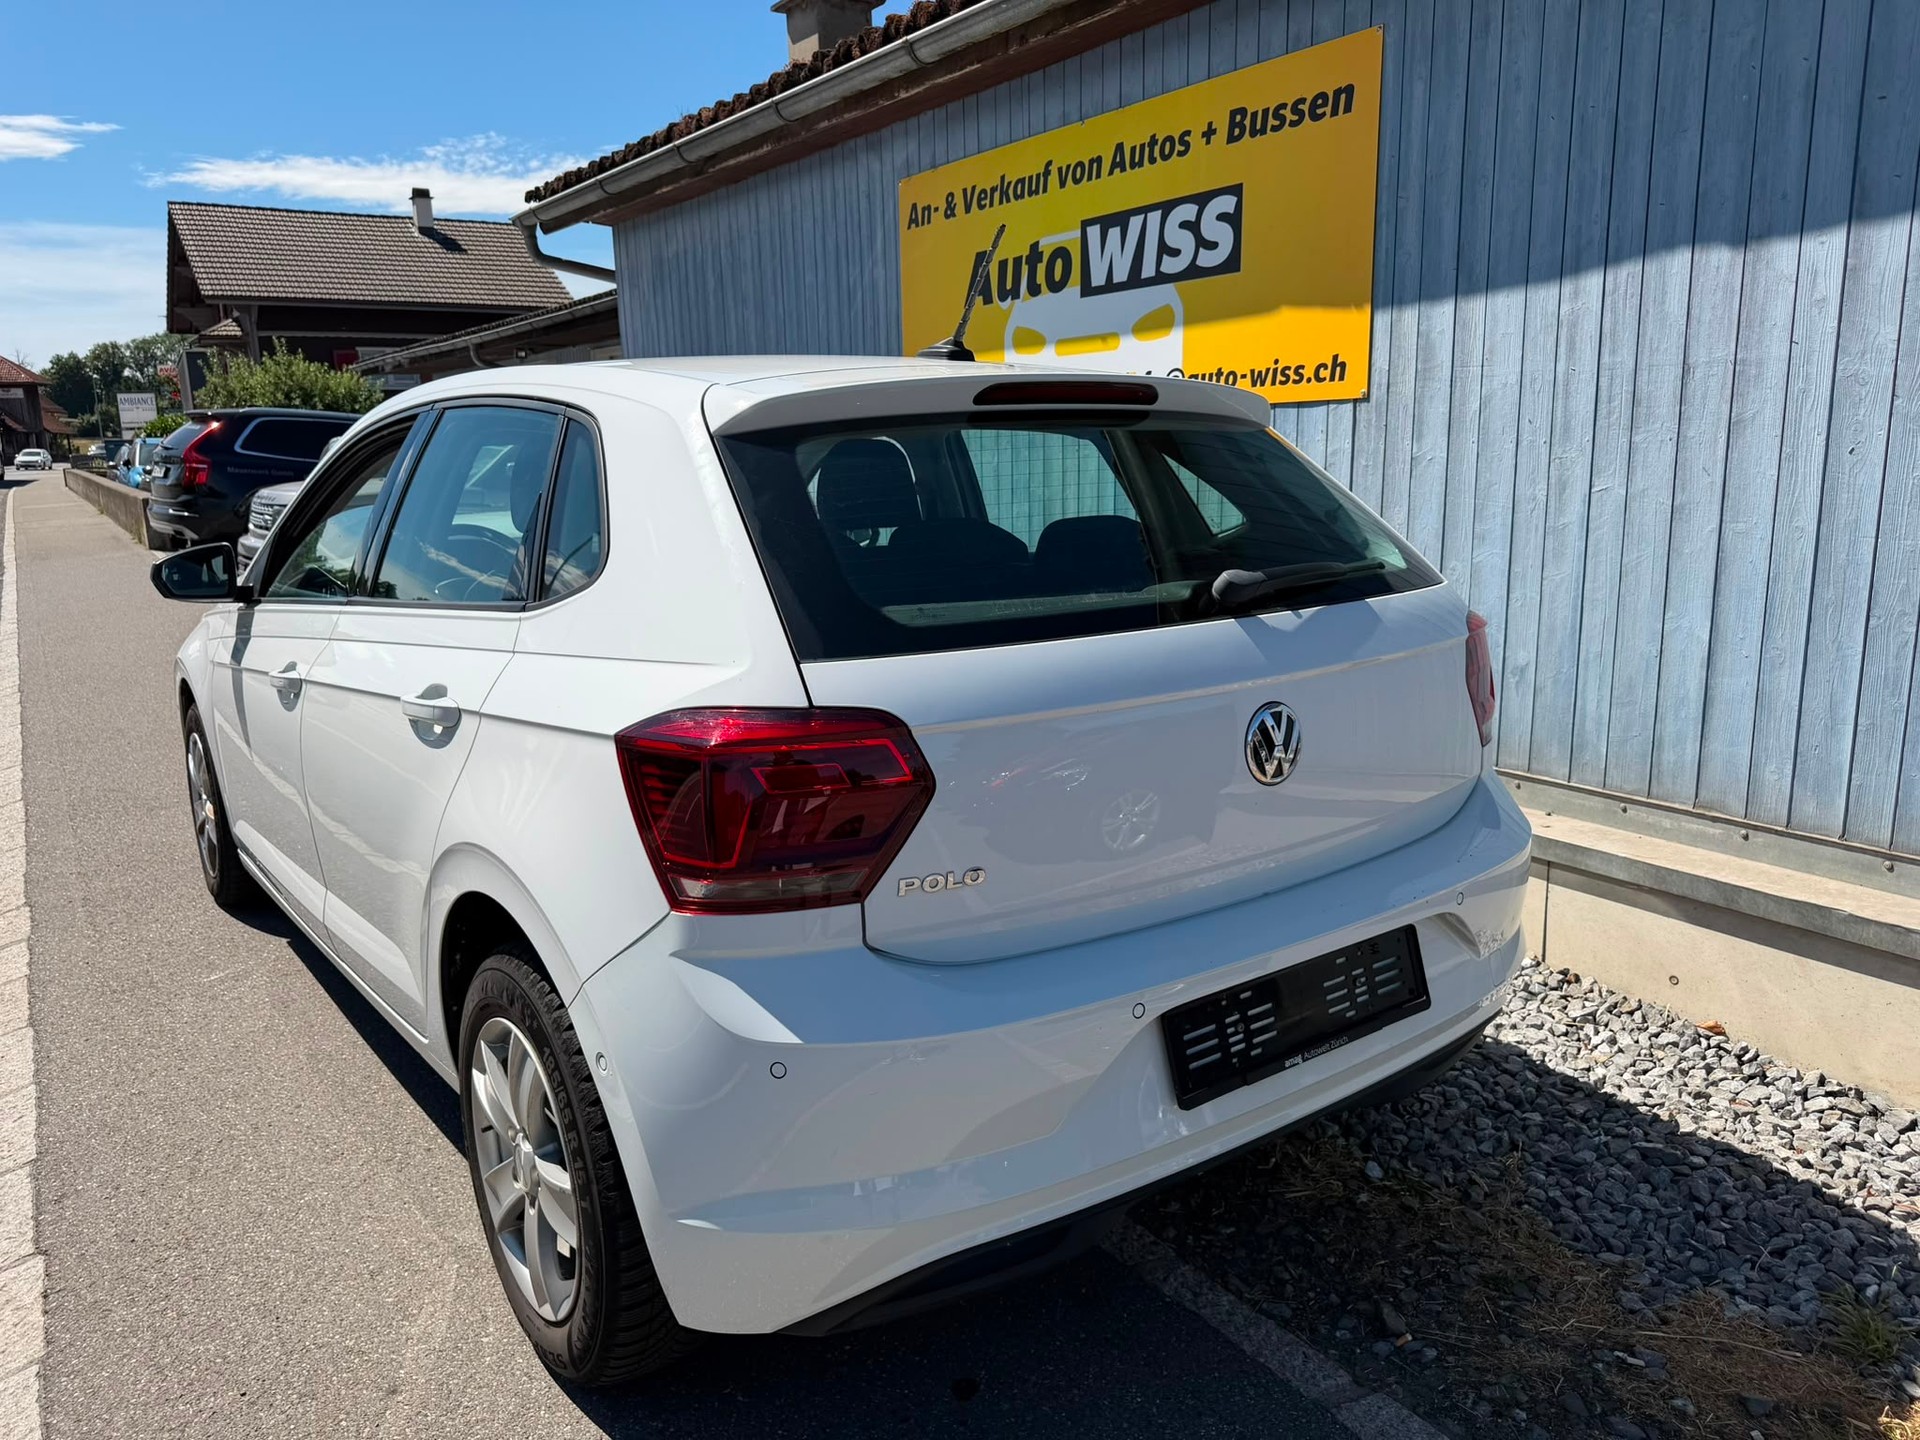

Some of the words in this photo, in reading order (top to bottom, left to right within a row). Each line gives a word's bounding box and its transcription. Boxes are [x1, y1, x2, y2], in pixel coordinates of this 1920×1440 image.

[907, 202, 939, 230] An-
[943, 191, 957, 220] &
[962, 159, 1053, 215] Verkauf
[1057, 154, 1103, 190] von
[1107, 129, 1192, 178] Autos
[1201, 120, 1217, 146] +
[1226, 83, 1355, 146] Bussen
[119, 396, 154, 406] AMBIANCE
[897, 866, 987, 897] POLO
[1284, 1054, 1303, 1068] amag
[1304, 1042, 1331, 1060] Autowelt
[1330, 1036, 1349, 1049] Zürich
[542, 1046, 574, 1124] 185/65
[568, 1130, 580, 1148] R
[574, 1159, 588, 1185] 15
